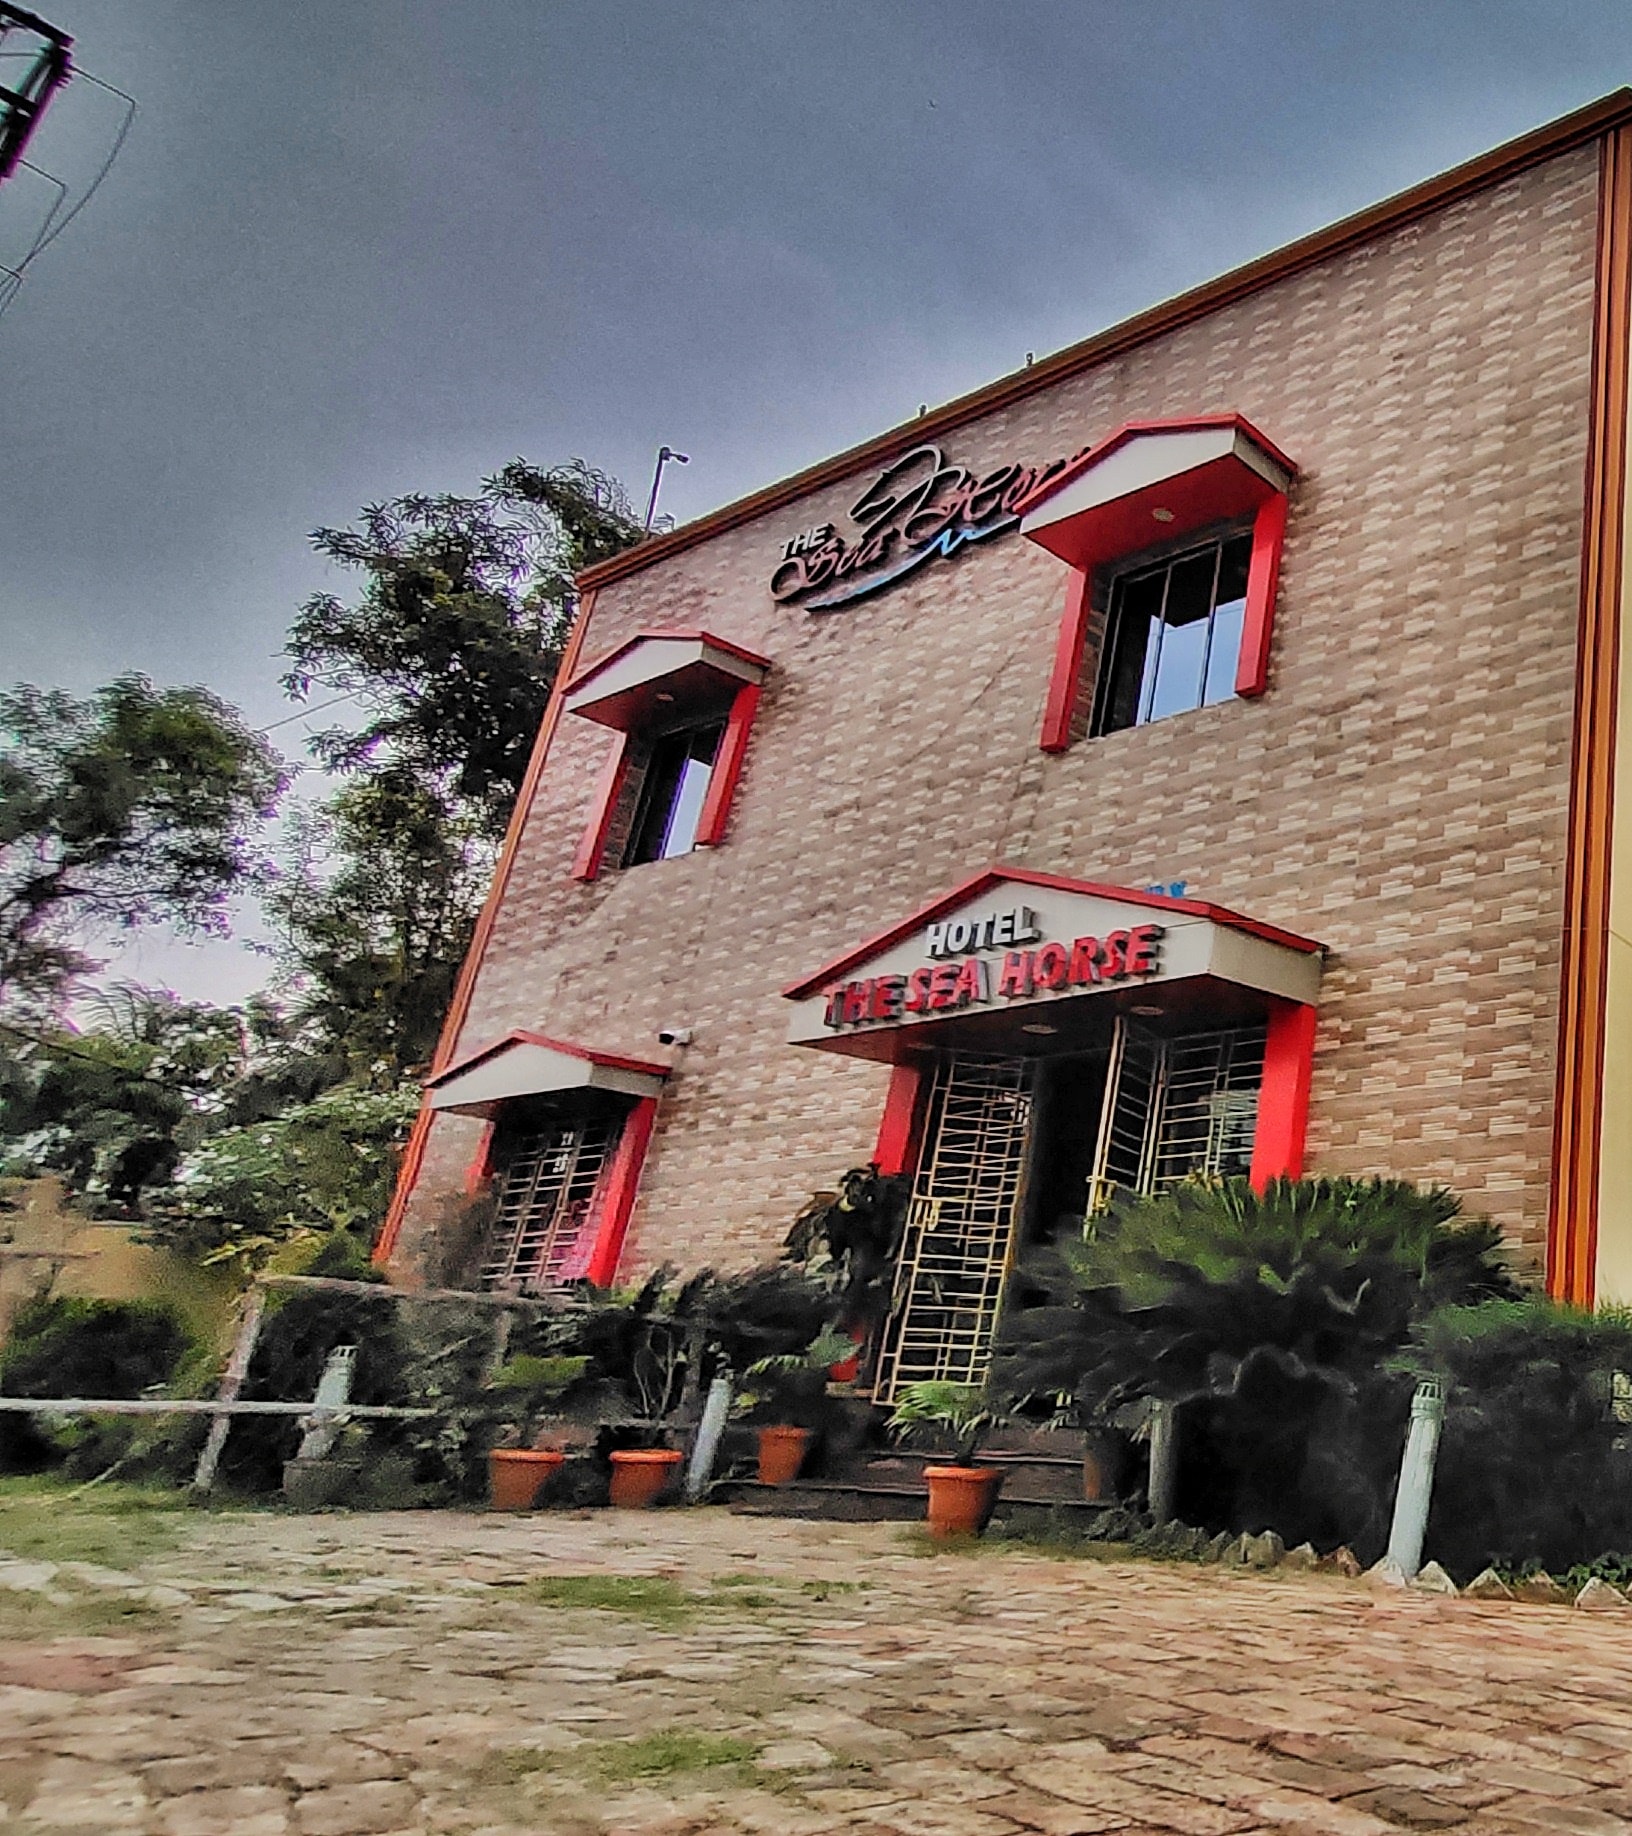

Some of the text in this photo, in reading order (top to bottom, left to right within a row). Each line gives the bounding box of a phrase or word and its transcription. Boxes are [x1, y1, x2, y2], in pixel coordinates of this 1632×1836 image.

[780, 523, 836, 560] THE
[925, 905, 1040, 957] HOTEL
[822, 923, 1166, 1028] THE SEA HORSE
